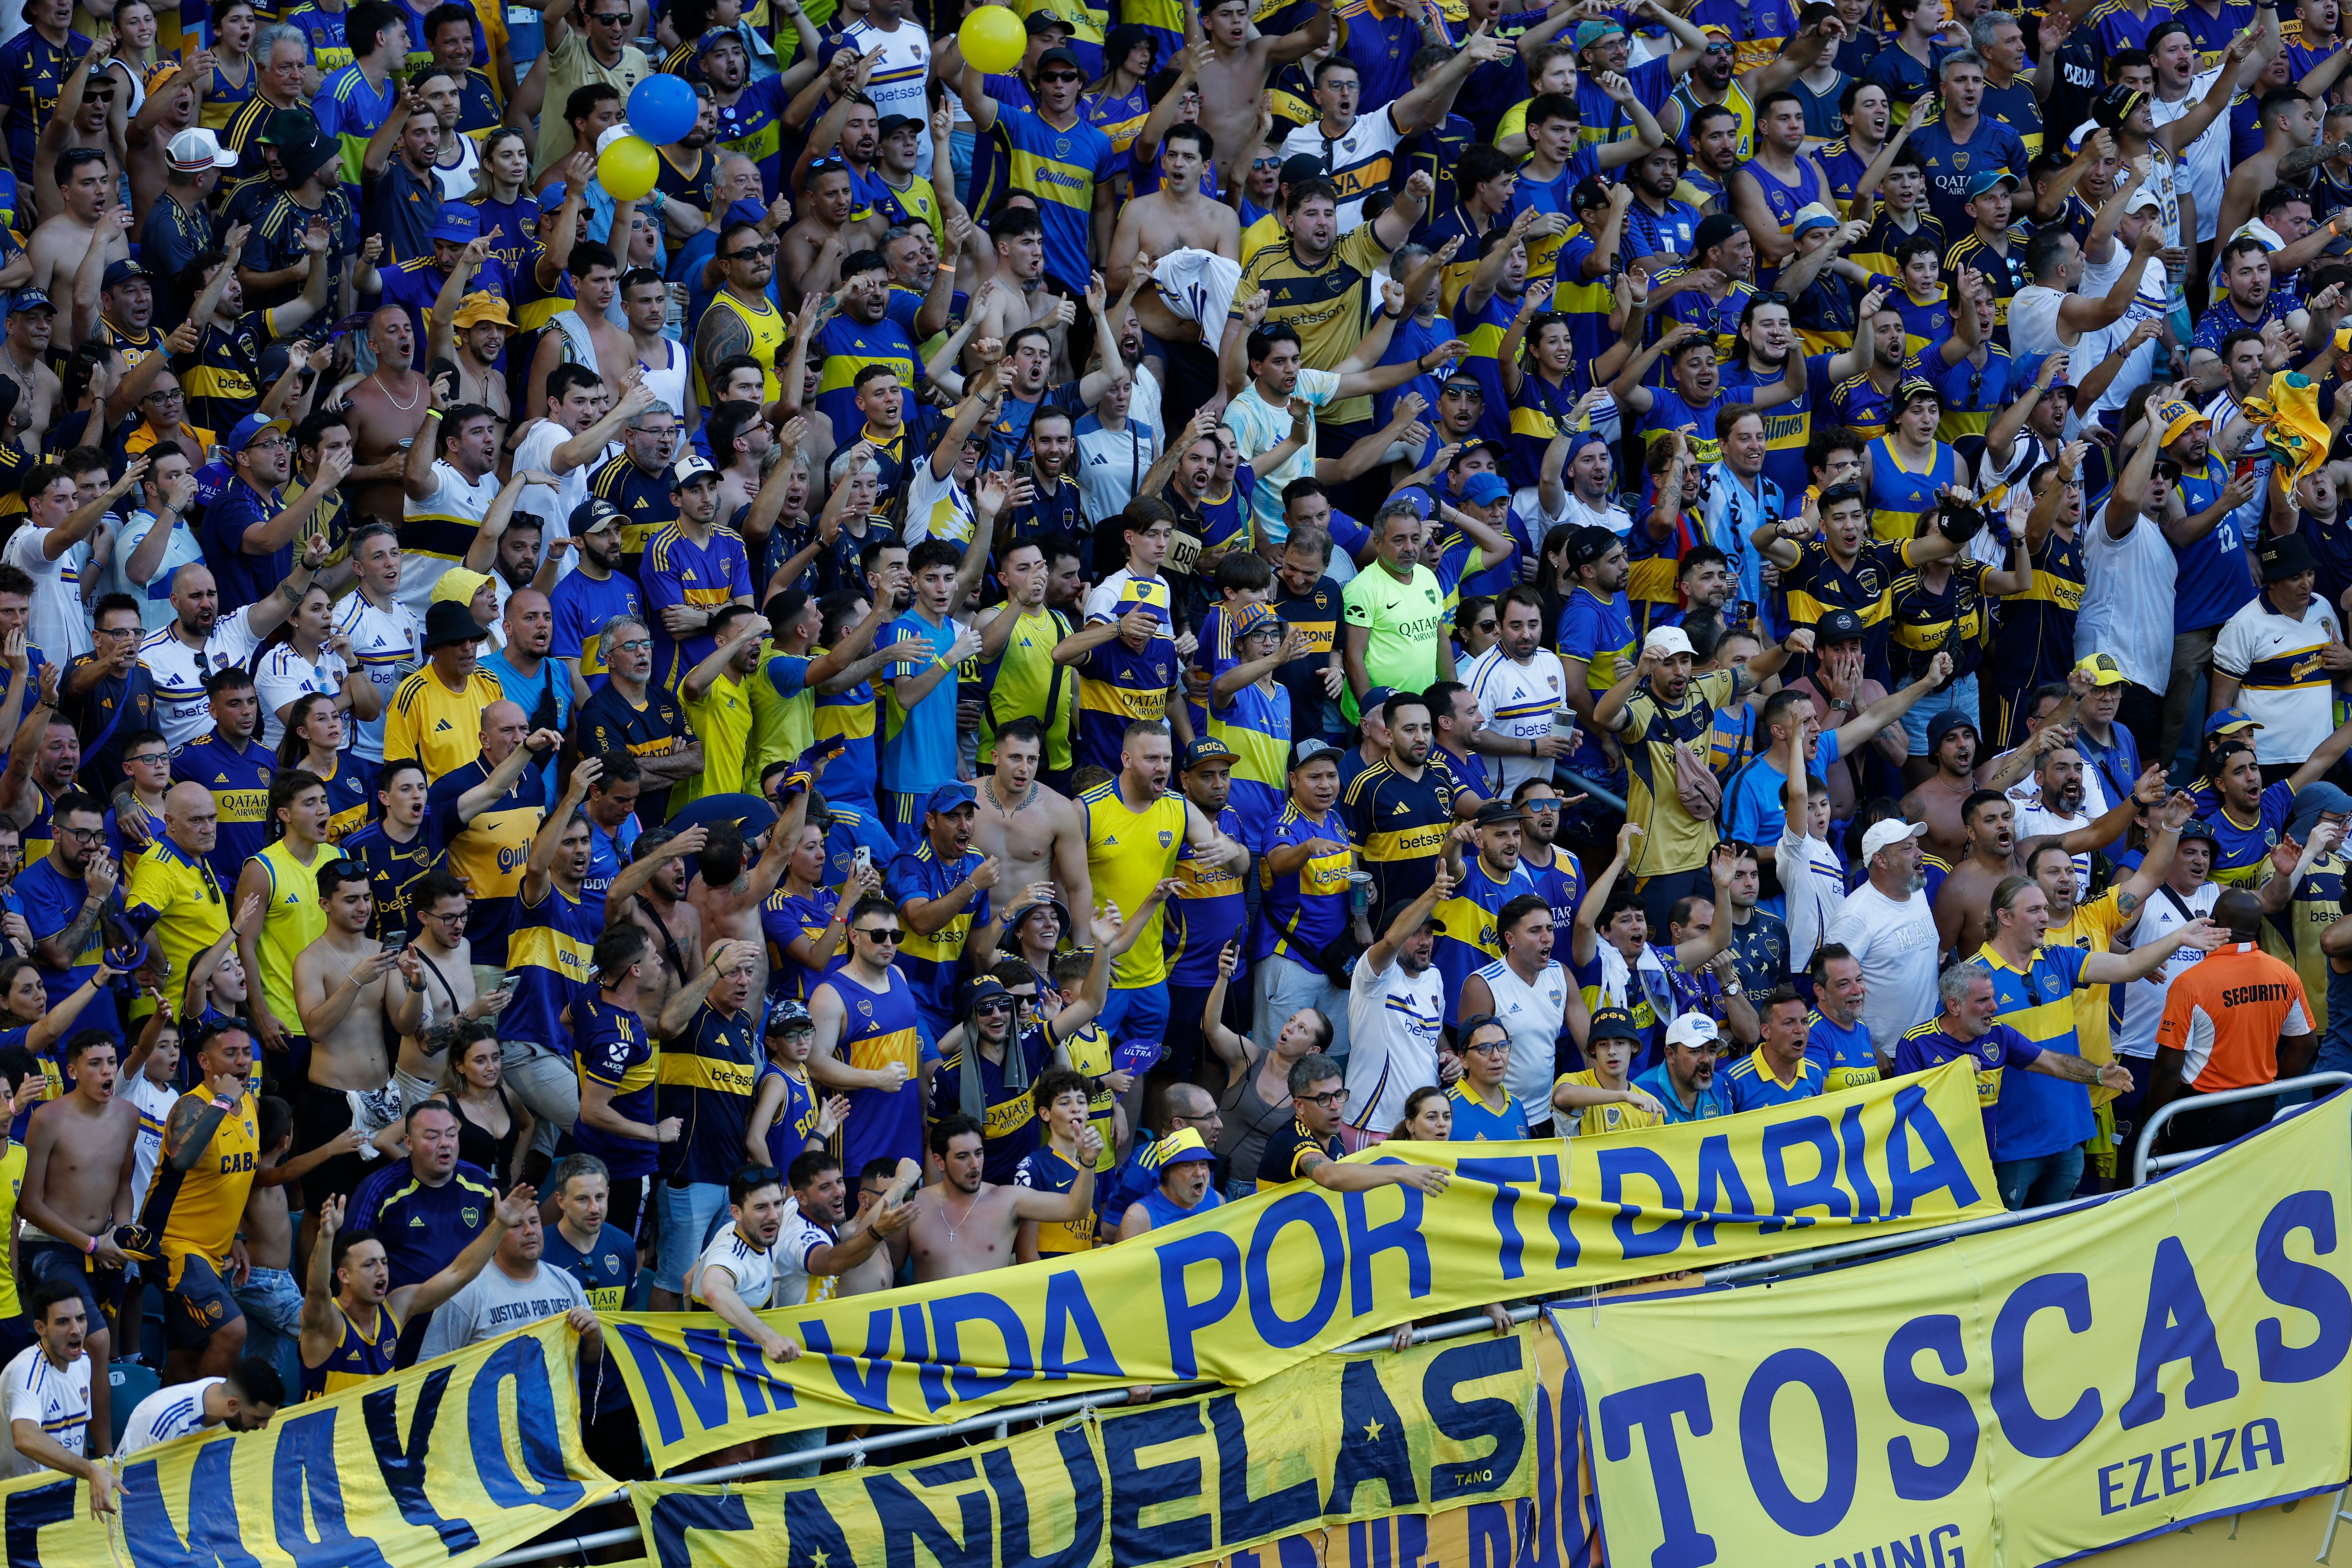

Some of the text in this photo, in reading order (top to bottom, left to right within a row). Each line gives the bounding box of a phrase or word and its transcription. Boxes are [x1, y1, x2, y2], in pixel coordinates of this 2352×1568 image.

[143, 61, 176, 79] CABJ
[1035, 166, 1084, 190] Quilmes
[2162, 199, 2177, 227] 12
[2326, 207, 2339, 216] BOCA
[458, 217, 471, 226] pax
[1279, 303, 1344, 326] betsson
[592, 505, 613, 515] LAKERS
[2217, 525, 2238, 554] 12
[1399, 617, 1438, 635] QATAR
[1122, 693, 1166, 708] QATAR
[1134, 706, 1165, 716] AIRWAYS
[1197, 742, 1224, 753] BOCA
[222, 795, 268, 810] QATAR
[236, 808, 266, 818] AIRWAYS
[2222, 984, 2289, 1008] SECURITY
[1692, 1019, 1711, 1028] Boca
[1125, 1048, 1152, 1058] ULTRA
[603, 1063, 624, 1072] AXION
[1845, 1073, 1875, 1088] QATAR
[987, 1101, 1029, 1123] QATAR
[616, 1083, 1981, 1447] MI VIDA POR TI DARIA
[210, 1305, 220, 1314] CABJ
[489, 1298, 571, 1324] JUSTICIA POR DIEGO
[112, 1374, 118, 1383] 7
[1599, 1190, 2352, 1568] TOSCAS
[123, 1335, 585, 1568] MAYO
[2099, 1417, 2285, 1516] EZEIZA
[1455, 1469, 1493, 1486] TANO
